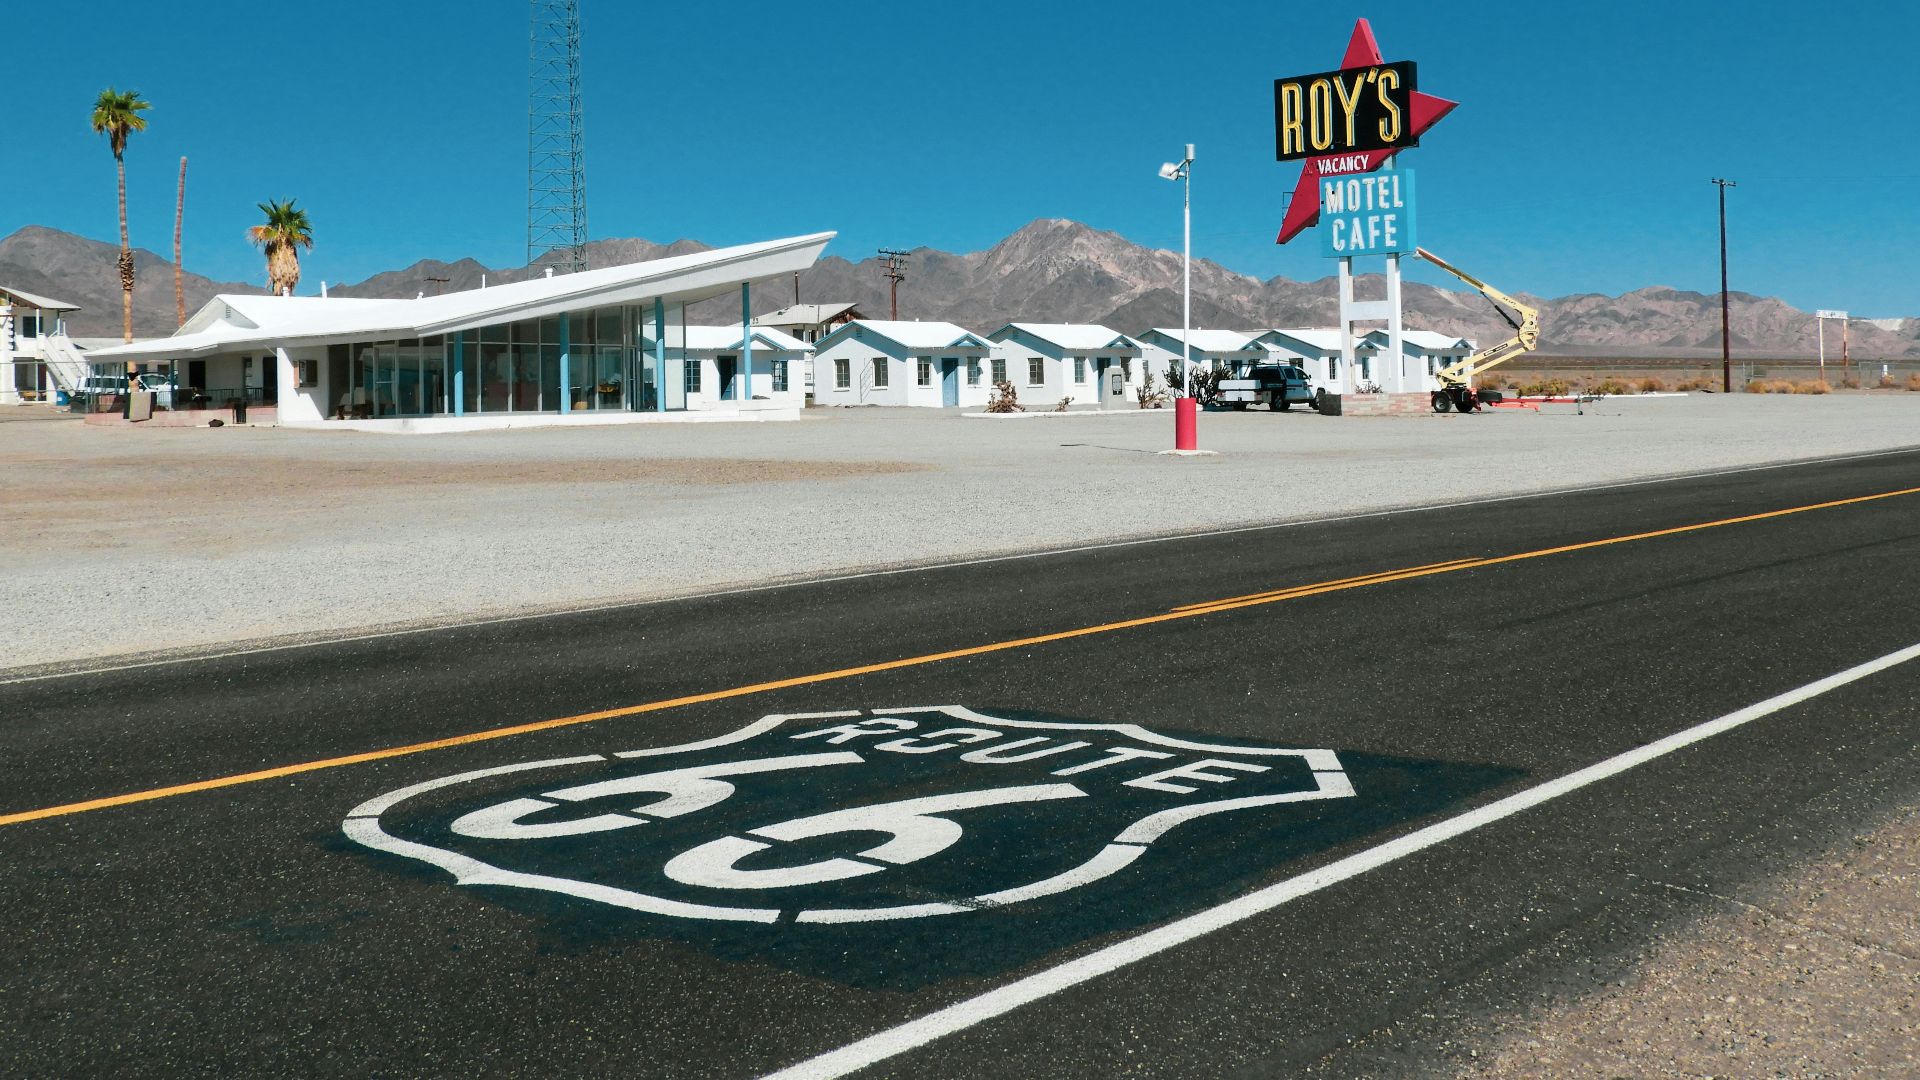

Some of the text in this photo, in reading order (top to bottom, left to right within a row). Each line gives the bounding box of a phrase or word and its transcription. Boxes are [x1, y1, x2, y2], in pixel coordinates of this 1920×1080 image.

[1281, 67, 1402, 155] ROY'S
[1317, 154, 1370, 175] VACANCY
[1325, 175, 1403, 214] MOTEL
[1332, 214, 1397, 251] CAFE
[791, 716, 1273, 795] ROUTE
[450, 752, 1088, 888] 66
